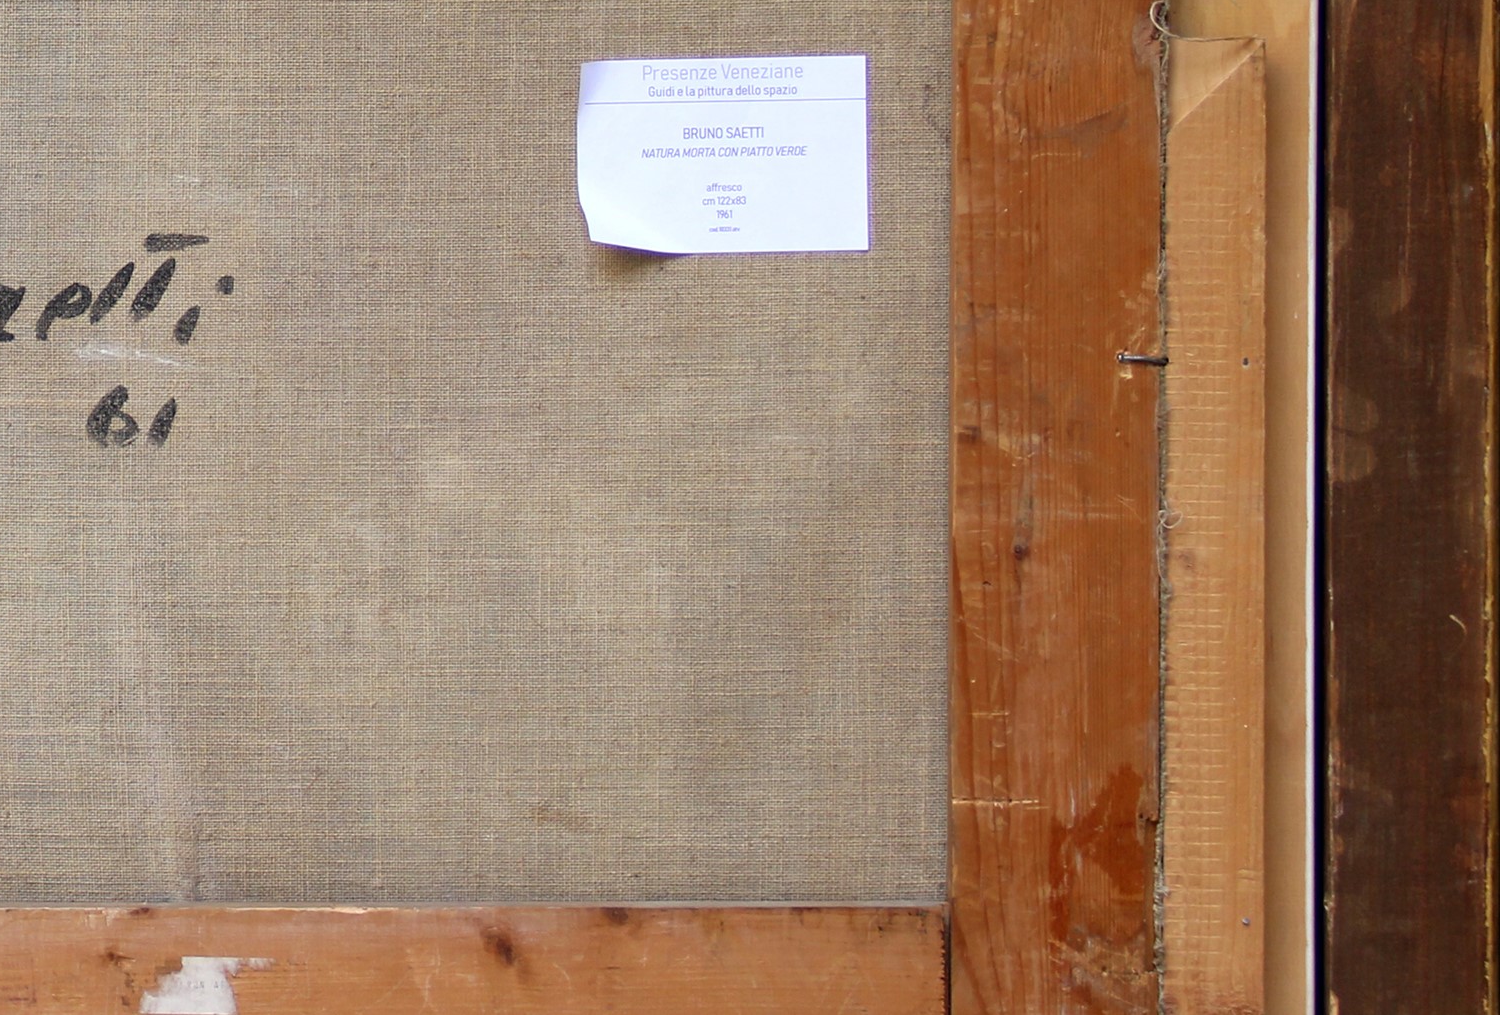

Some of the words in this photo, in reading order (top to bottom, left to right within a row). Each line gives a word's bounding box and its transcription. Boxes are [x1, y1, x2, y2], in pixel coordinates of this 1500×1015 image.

[642, 65, 717, 82] Presenze
[721, 63, 804, 80] Veneziane
[648, 86, 675, 98] Guidi
[677, 88, 684, 96] e
[685, 86, 696, 97] la
[697, 86, 733, 99] pittura
[735, 85, 761, 96] dello
[763, 85, 798, 98] spazio
[683, 128, 723, 140] BRUNO
[726, 126, 765, 139] SAETTI
[641, 148, 681, 158] NATURA
[681, 147, 717, 157] MORTA
[718, 147, 739, 157] CON
[740, 146, 774, 157] PIATTO
[775, 146, 808, 156] VERDE
[706, 183, 742, 192] affresco
[717, 196, 747, 205] 122x83
[716, 210, 733, 219] 1961
